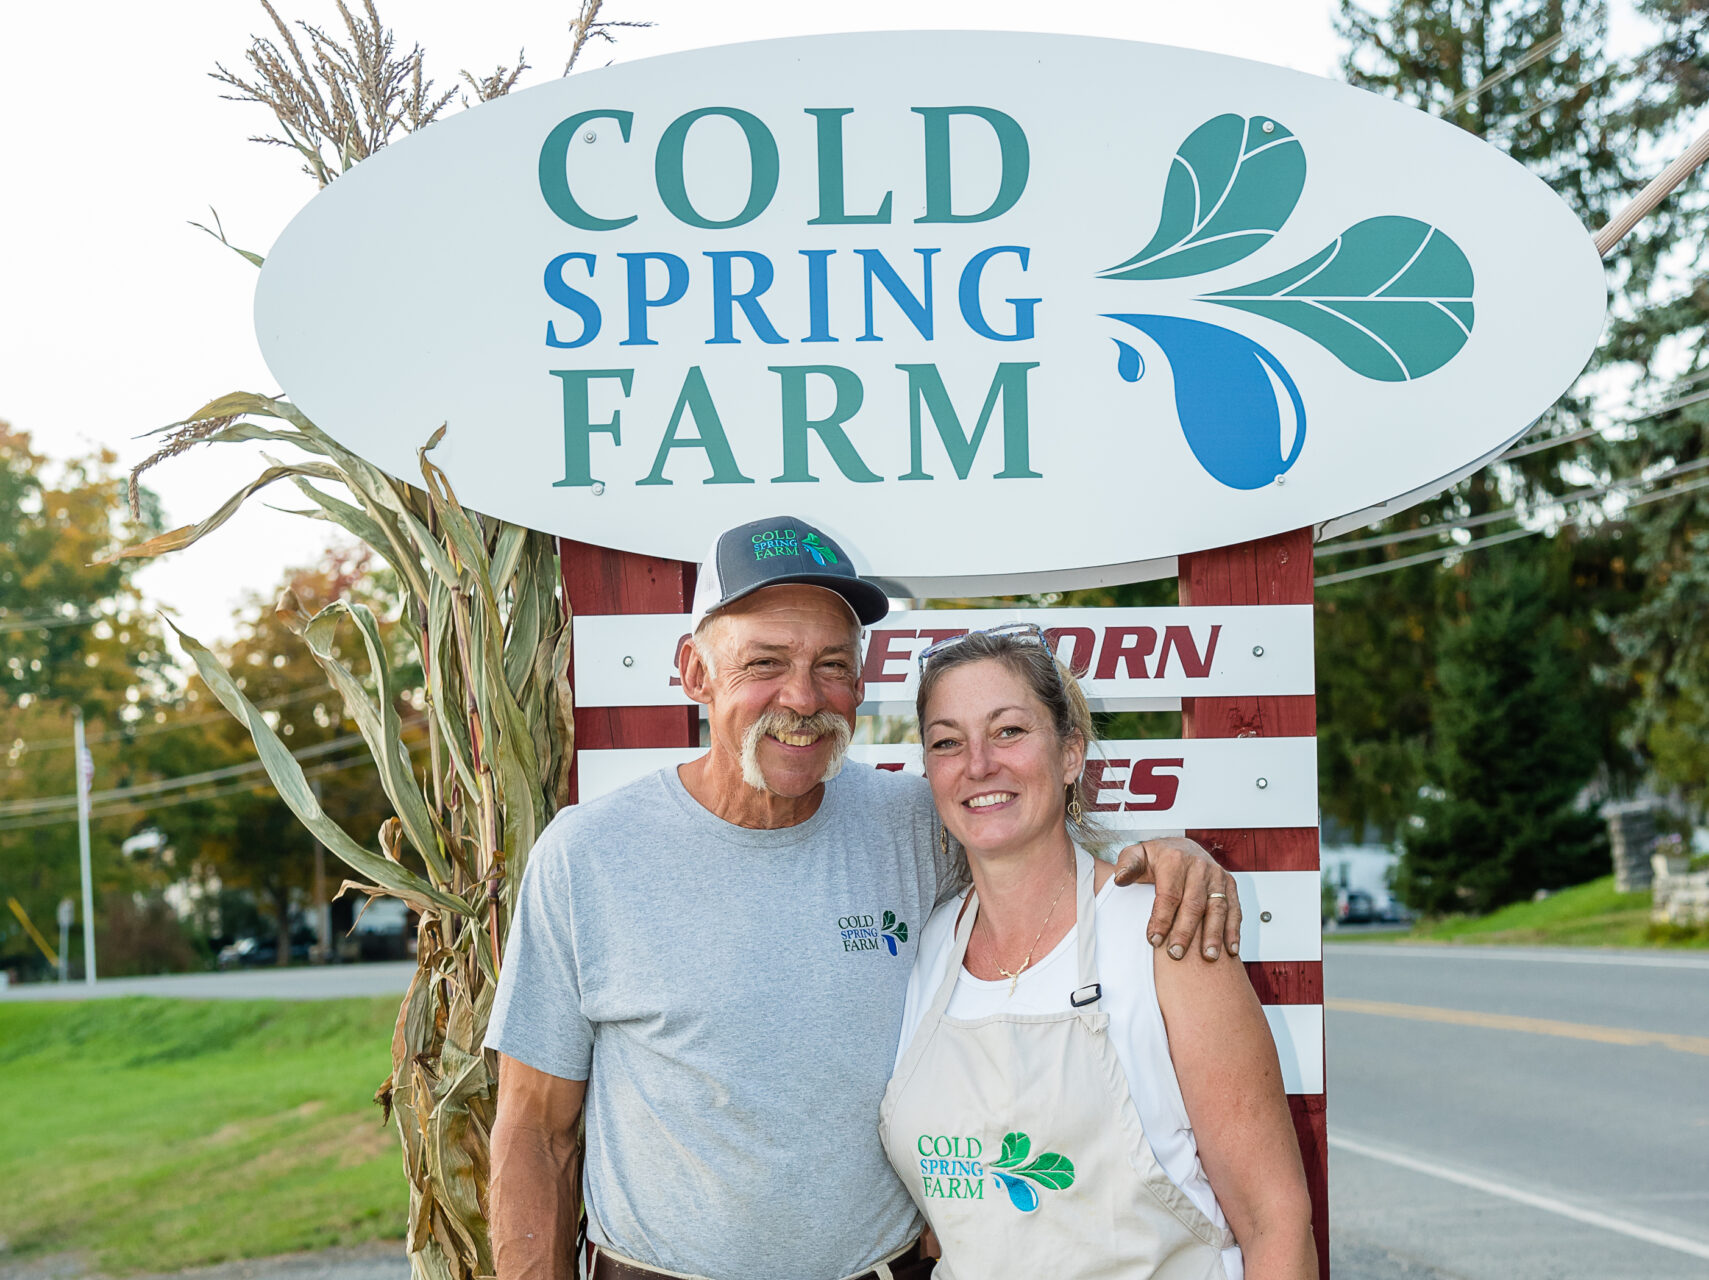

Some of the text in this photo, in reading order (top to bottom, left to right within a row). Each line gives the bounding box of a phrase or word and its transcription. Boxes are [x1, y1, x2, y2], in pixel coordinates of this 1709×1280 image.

[538, 106, 1031, 231] COLD
[543, 245, 1043, 349] SPRING
[549, 362, 1044, 488] FARM
[752, 530, 796, 544] COLD
[754, 540, 798, 552] SPRING
[754, 546, 800, 560] FARM
[1036, 625, 1222, 680] ORN
[838, 915, 874, 930] COLD
[840, 928, 878, 940] SPRING
[843, 938, 879, 952] FARM
[917, 1134, 983, 1159] COLD
[920, 1158, 984, 1177] SPRING
[922, 1176, 985, 1200] FARM
